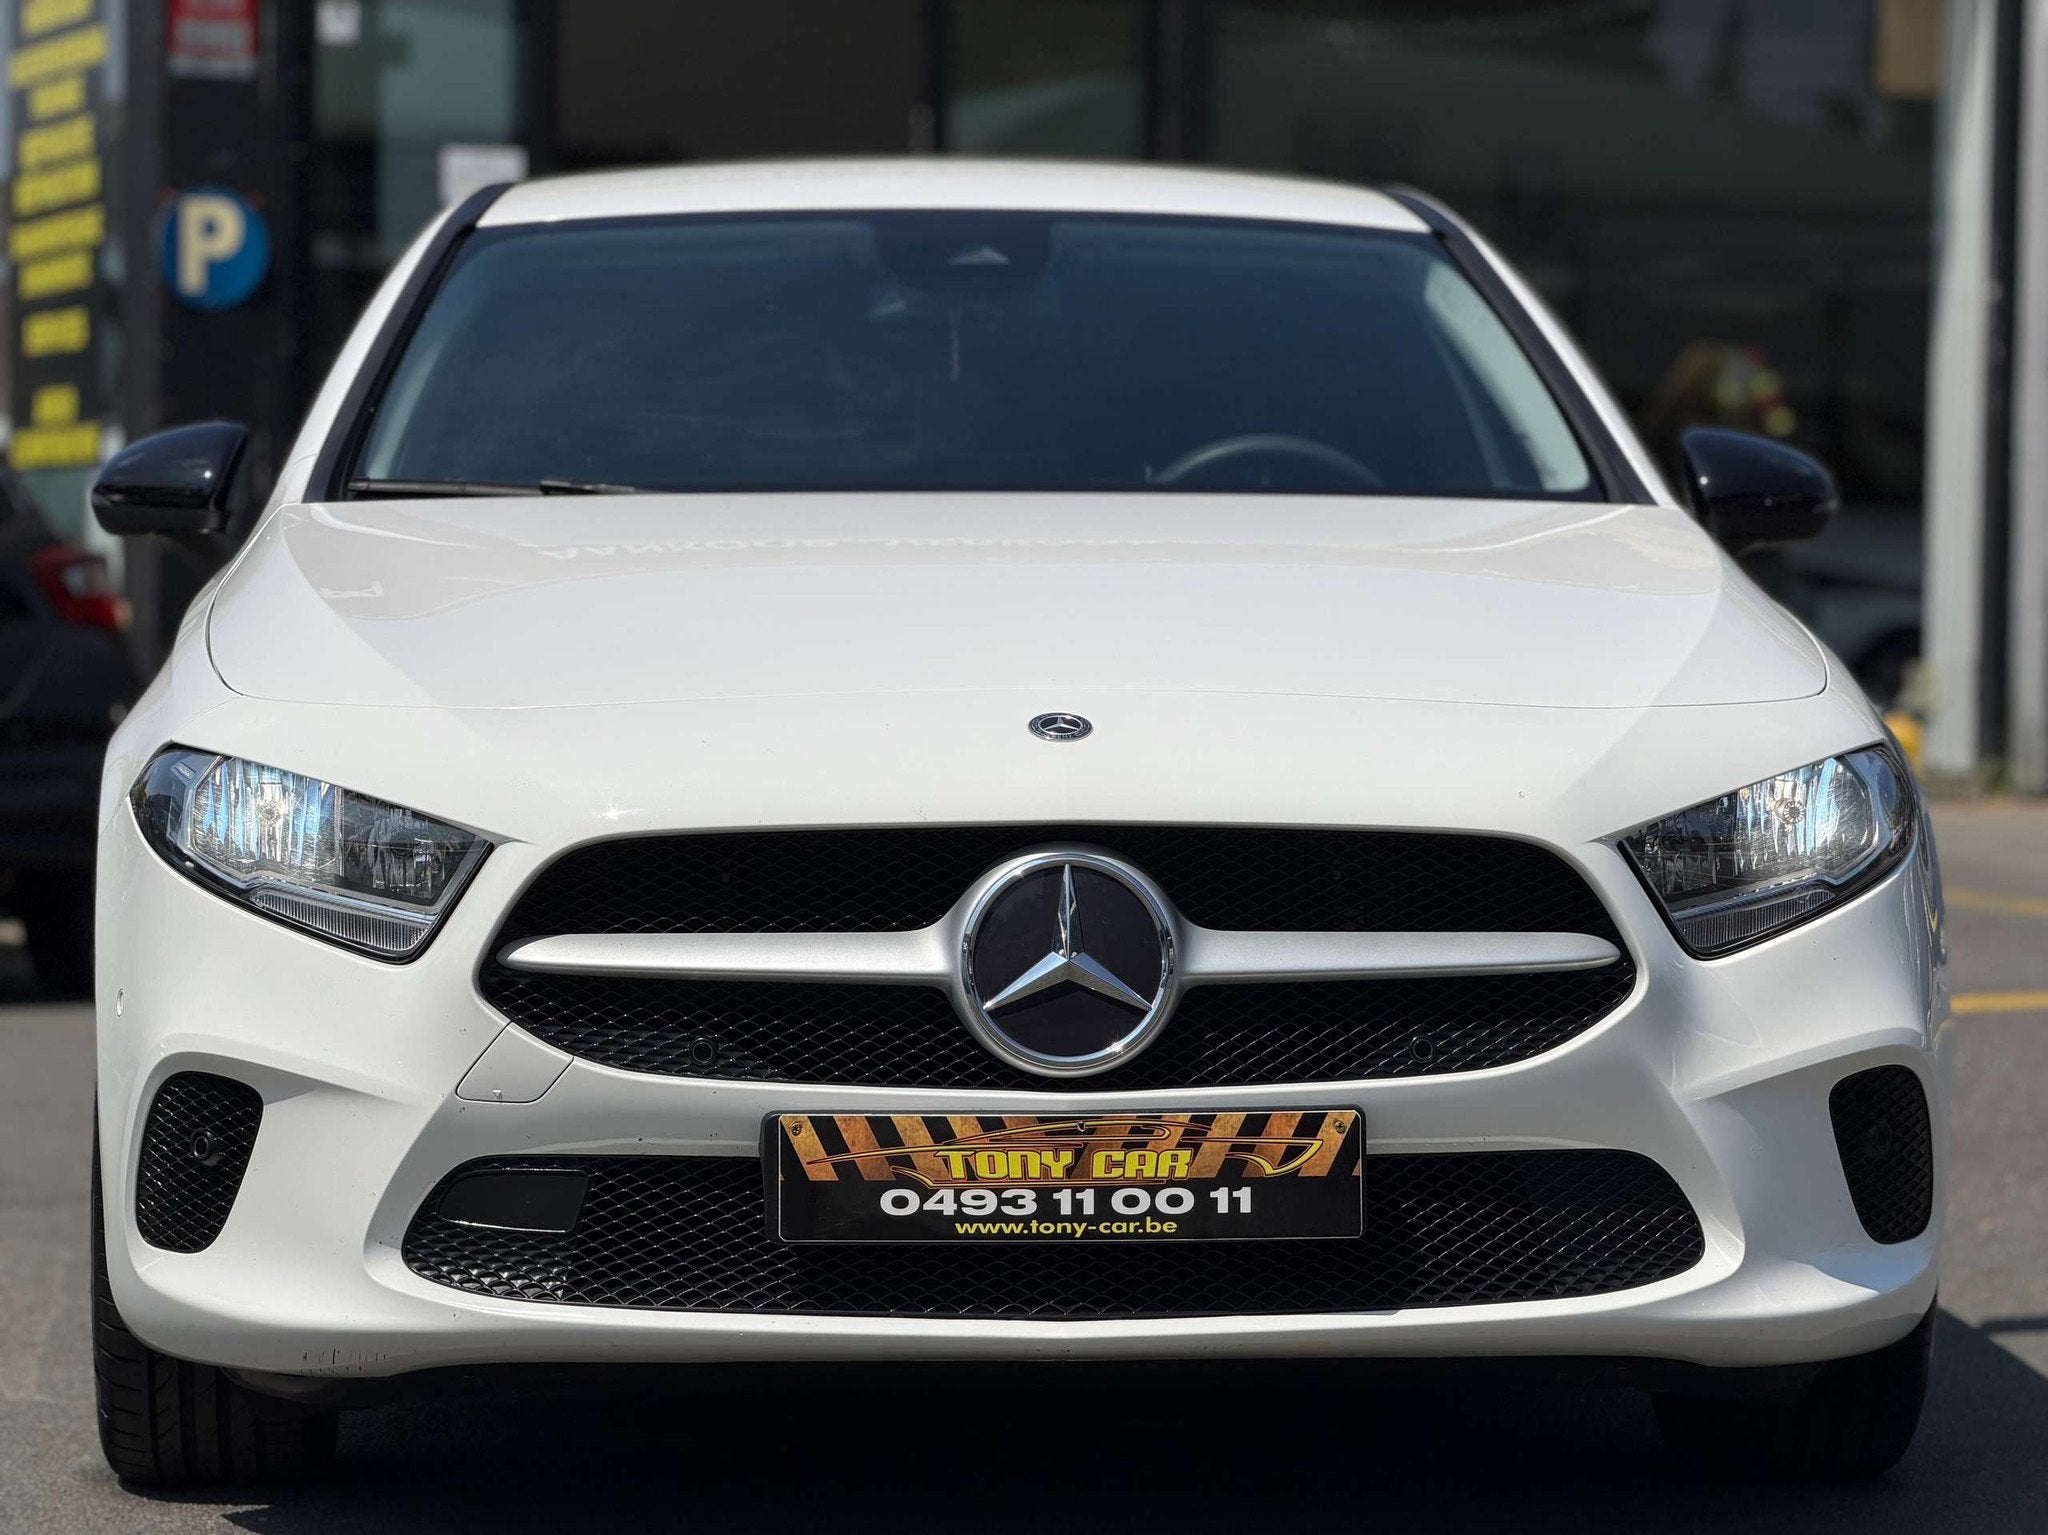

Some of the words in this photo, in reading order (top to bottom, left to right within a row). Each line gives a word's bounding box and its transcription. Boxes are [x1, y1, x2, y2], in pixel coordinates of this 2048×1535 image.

[176, 195, 246, 297] P
[936, 1149, 1073, 1181] TONY
[1092, 1149, 1192, 1181] CAR
[879, 1187, 1037, 1216] 0493
[1052, 1188, 1095, 1215] 11
[1110, 1187, 1195, 1215] 00
[1209, 1186, 1252, 1214] 11
[954, 1216, 1178, 1238] www.tony-car.be
